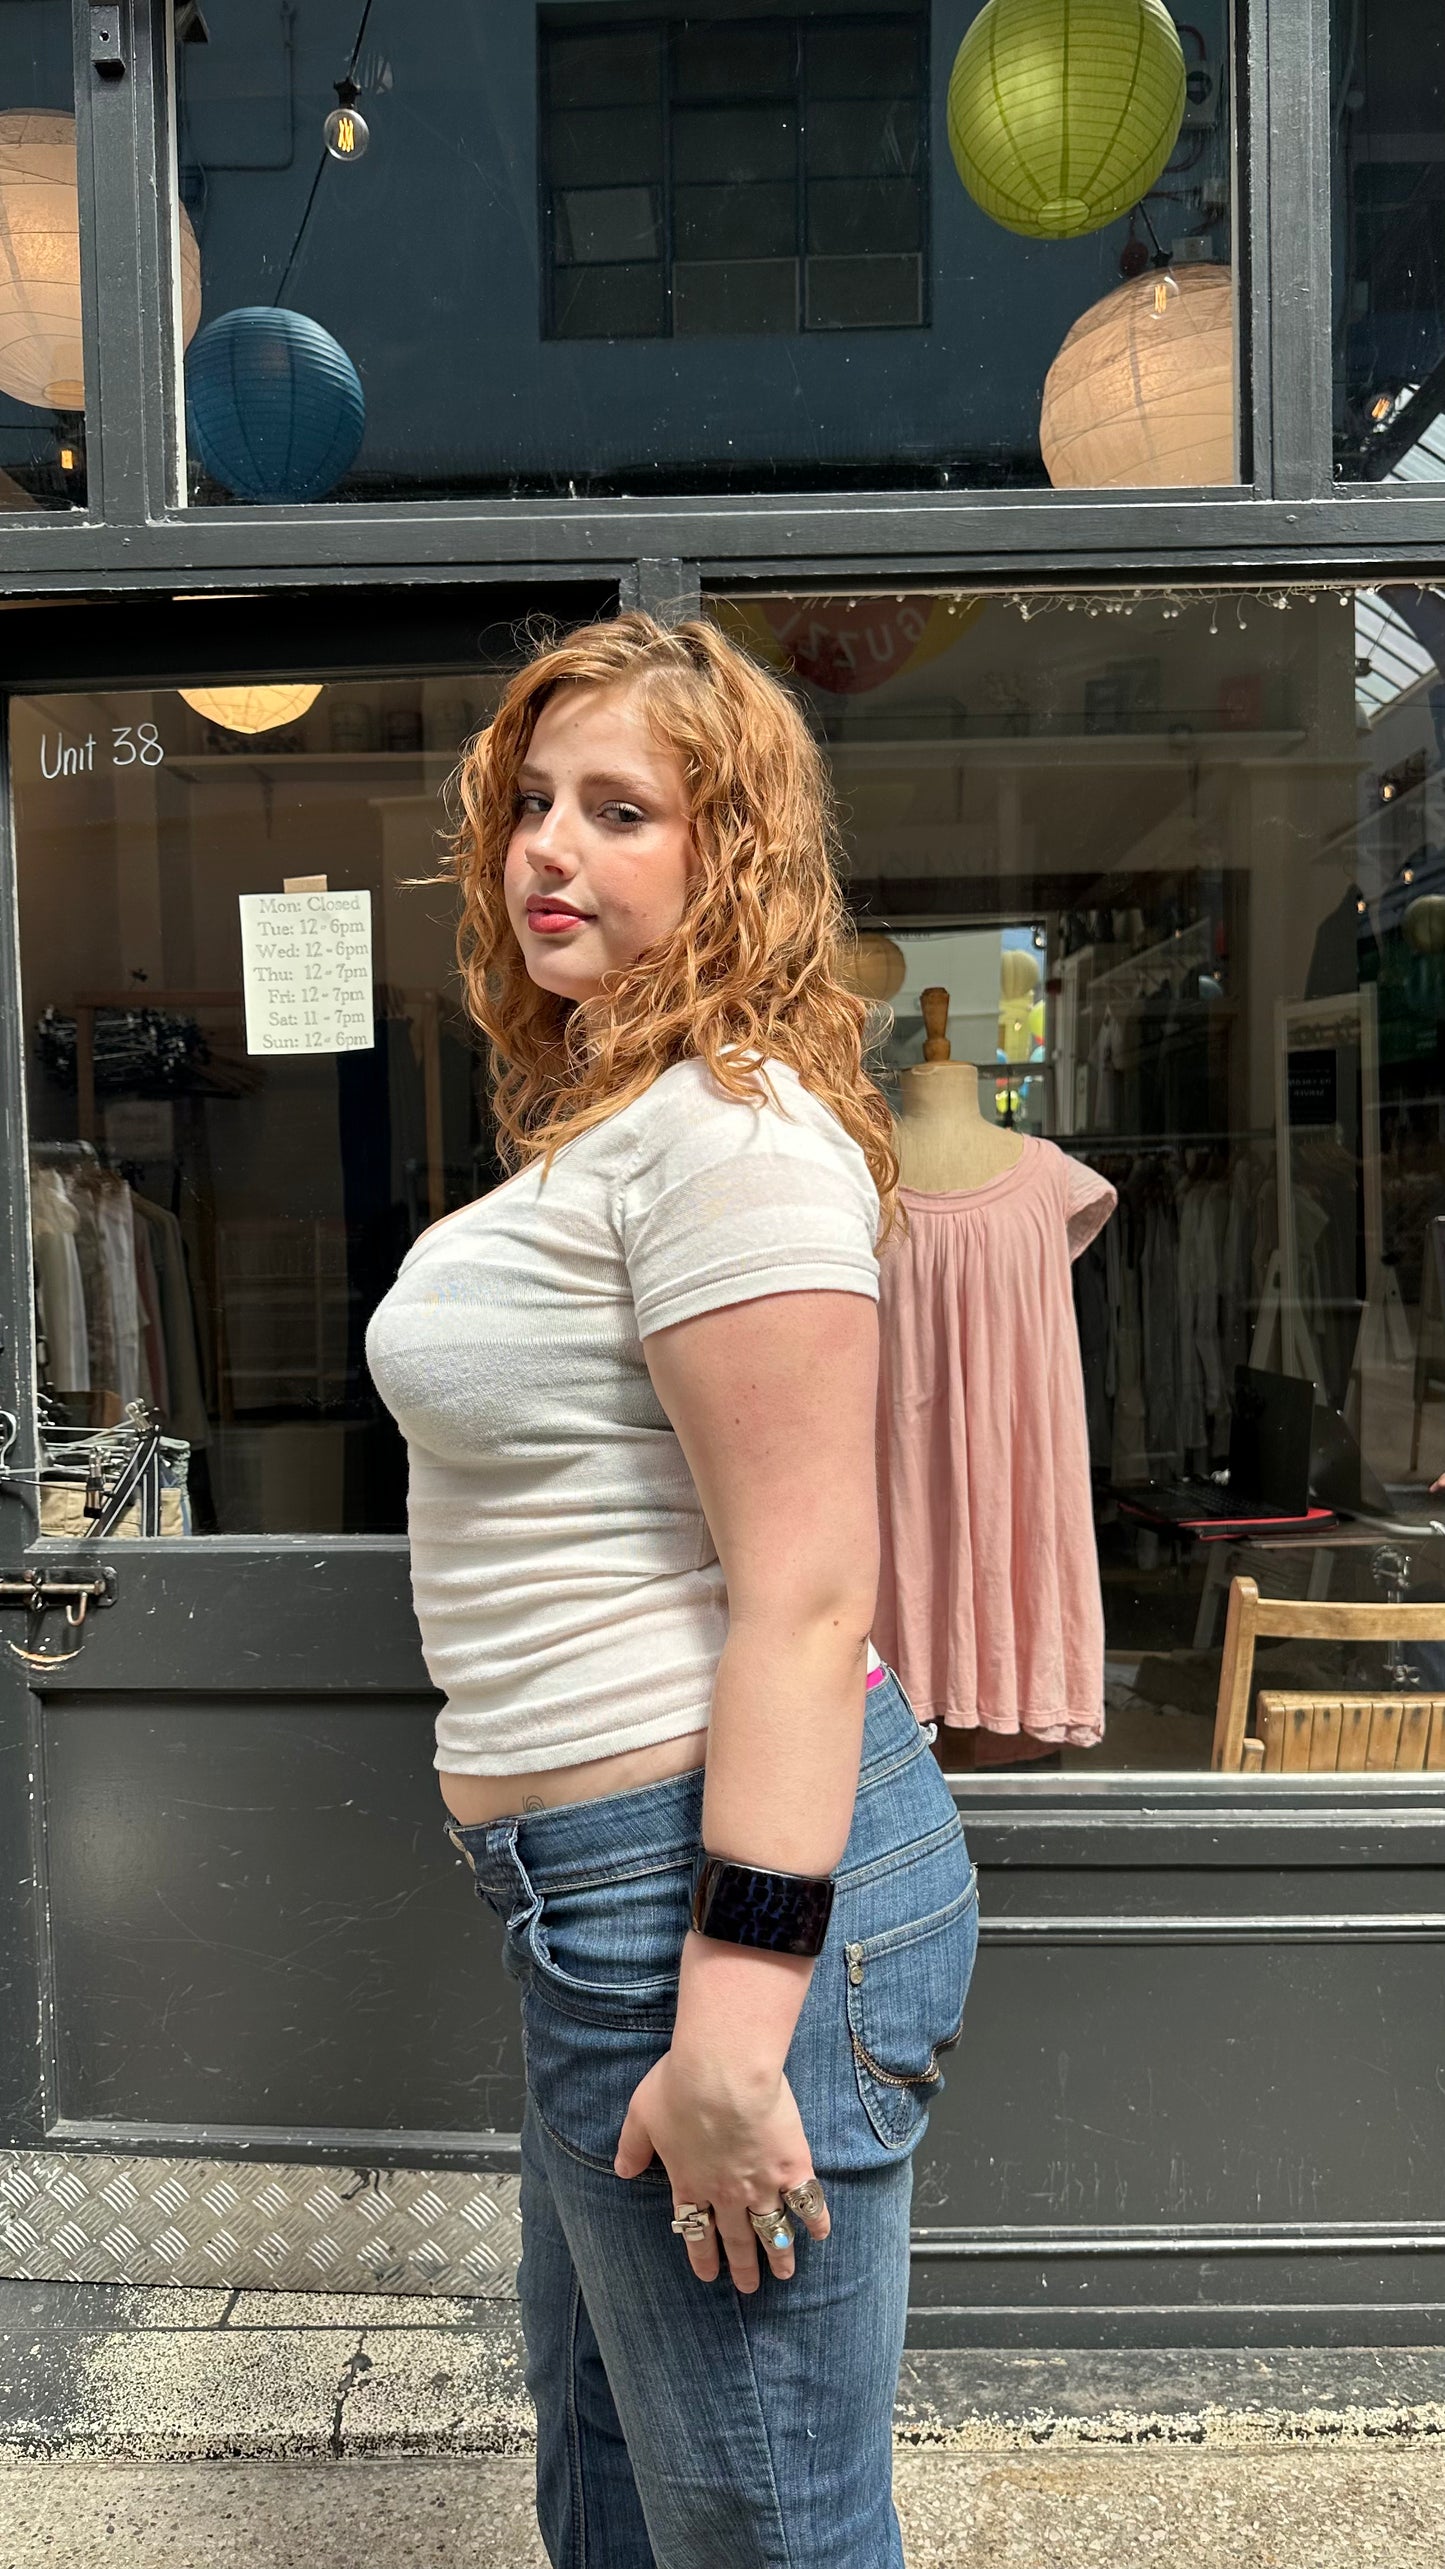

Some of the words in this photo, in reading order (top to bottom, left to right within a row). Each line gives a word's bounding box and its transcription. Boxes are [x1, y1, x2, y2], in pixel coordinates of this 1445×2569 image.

[40, 732, 97, 779] Unit
[111, 722, 164, 766] 38
[259, 898, 302, 914] Mon:
[306, 895, 361, 912] Closed
[257, 921, 295, 936] Tue:
[299, 918, 319, 935] 12
[329, 918, 366, 938] 6pm
[255, 943, 300, 959] Wed:
[305, 941, 323, 958] 12
[335, 940, 369, 960] 6pm
[253, 967, 294, 982] Thu:
[304, 963, 323, 980] 12
[335, 963, 369, 983] 7pm
[267, 988, 296, 1004] Fri:
[301, 986, 320, 1003] 12
[332, 987, 365, 1006] 7pm
[268, 1011, 299, 1026] Sat:
[303, 1010, 319, 1026] 11
[334, 1009, 366, 1028] 7pm
[262, 1033, 299, 1049] Sun:
[304, 1031, 323, 1048] 12
[335, 1031, 369, 1051] 6pm
